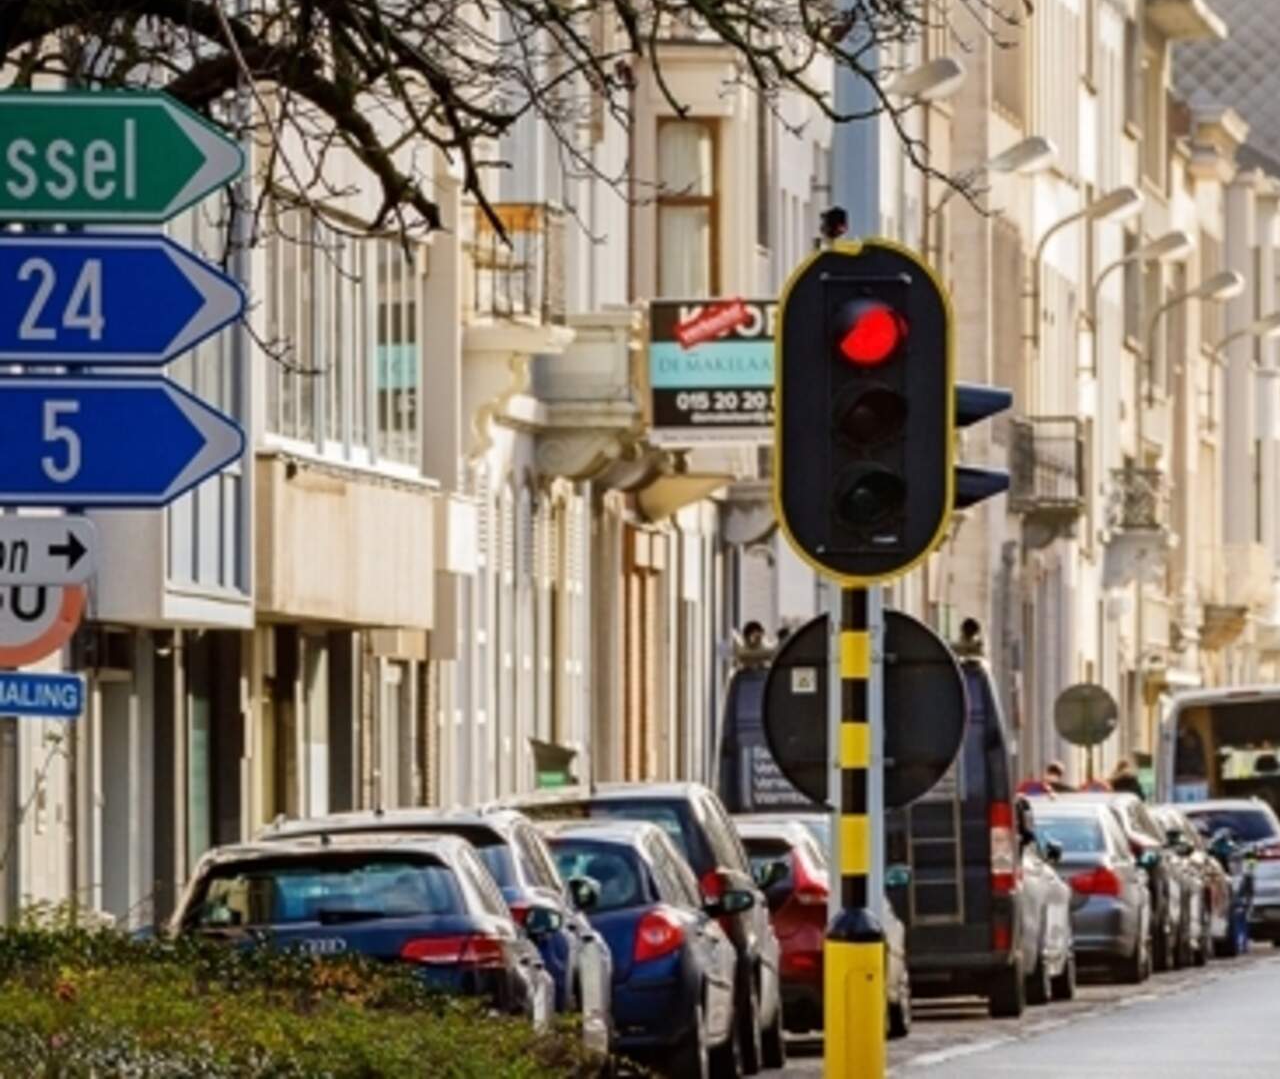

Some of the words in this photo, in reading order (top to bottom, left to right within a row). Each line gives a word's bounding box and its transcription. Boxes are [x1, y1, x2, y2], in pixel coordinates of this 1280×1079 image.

[5, 118, 137, 201] ssel
[17, 257, 106, 340] 24
[41, 399, 82, 482] 5
